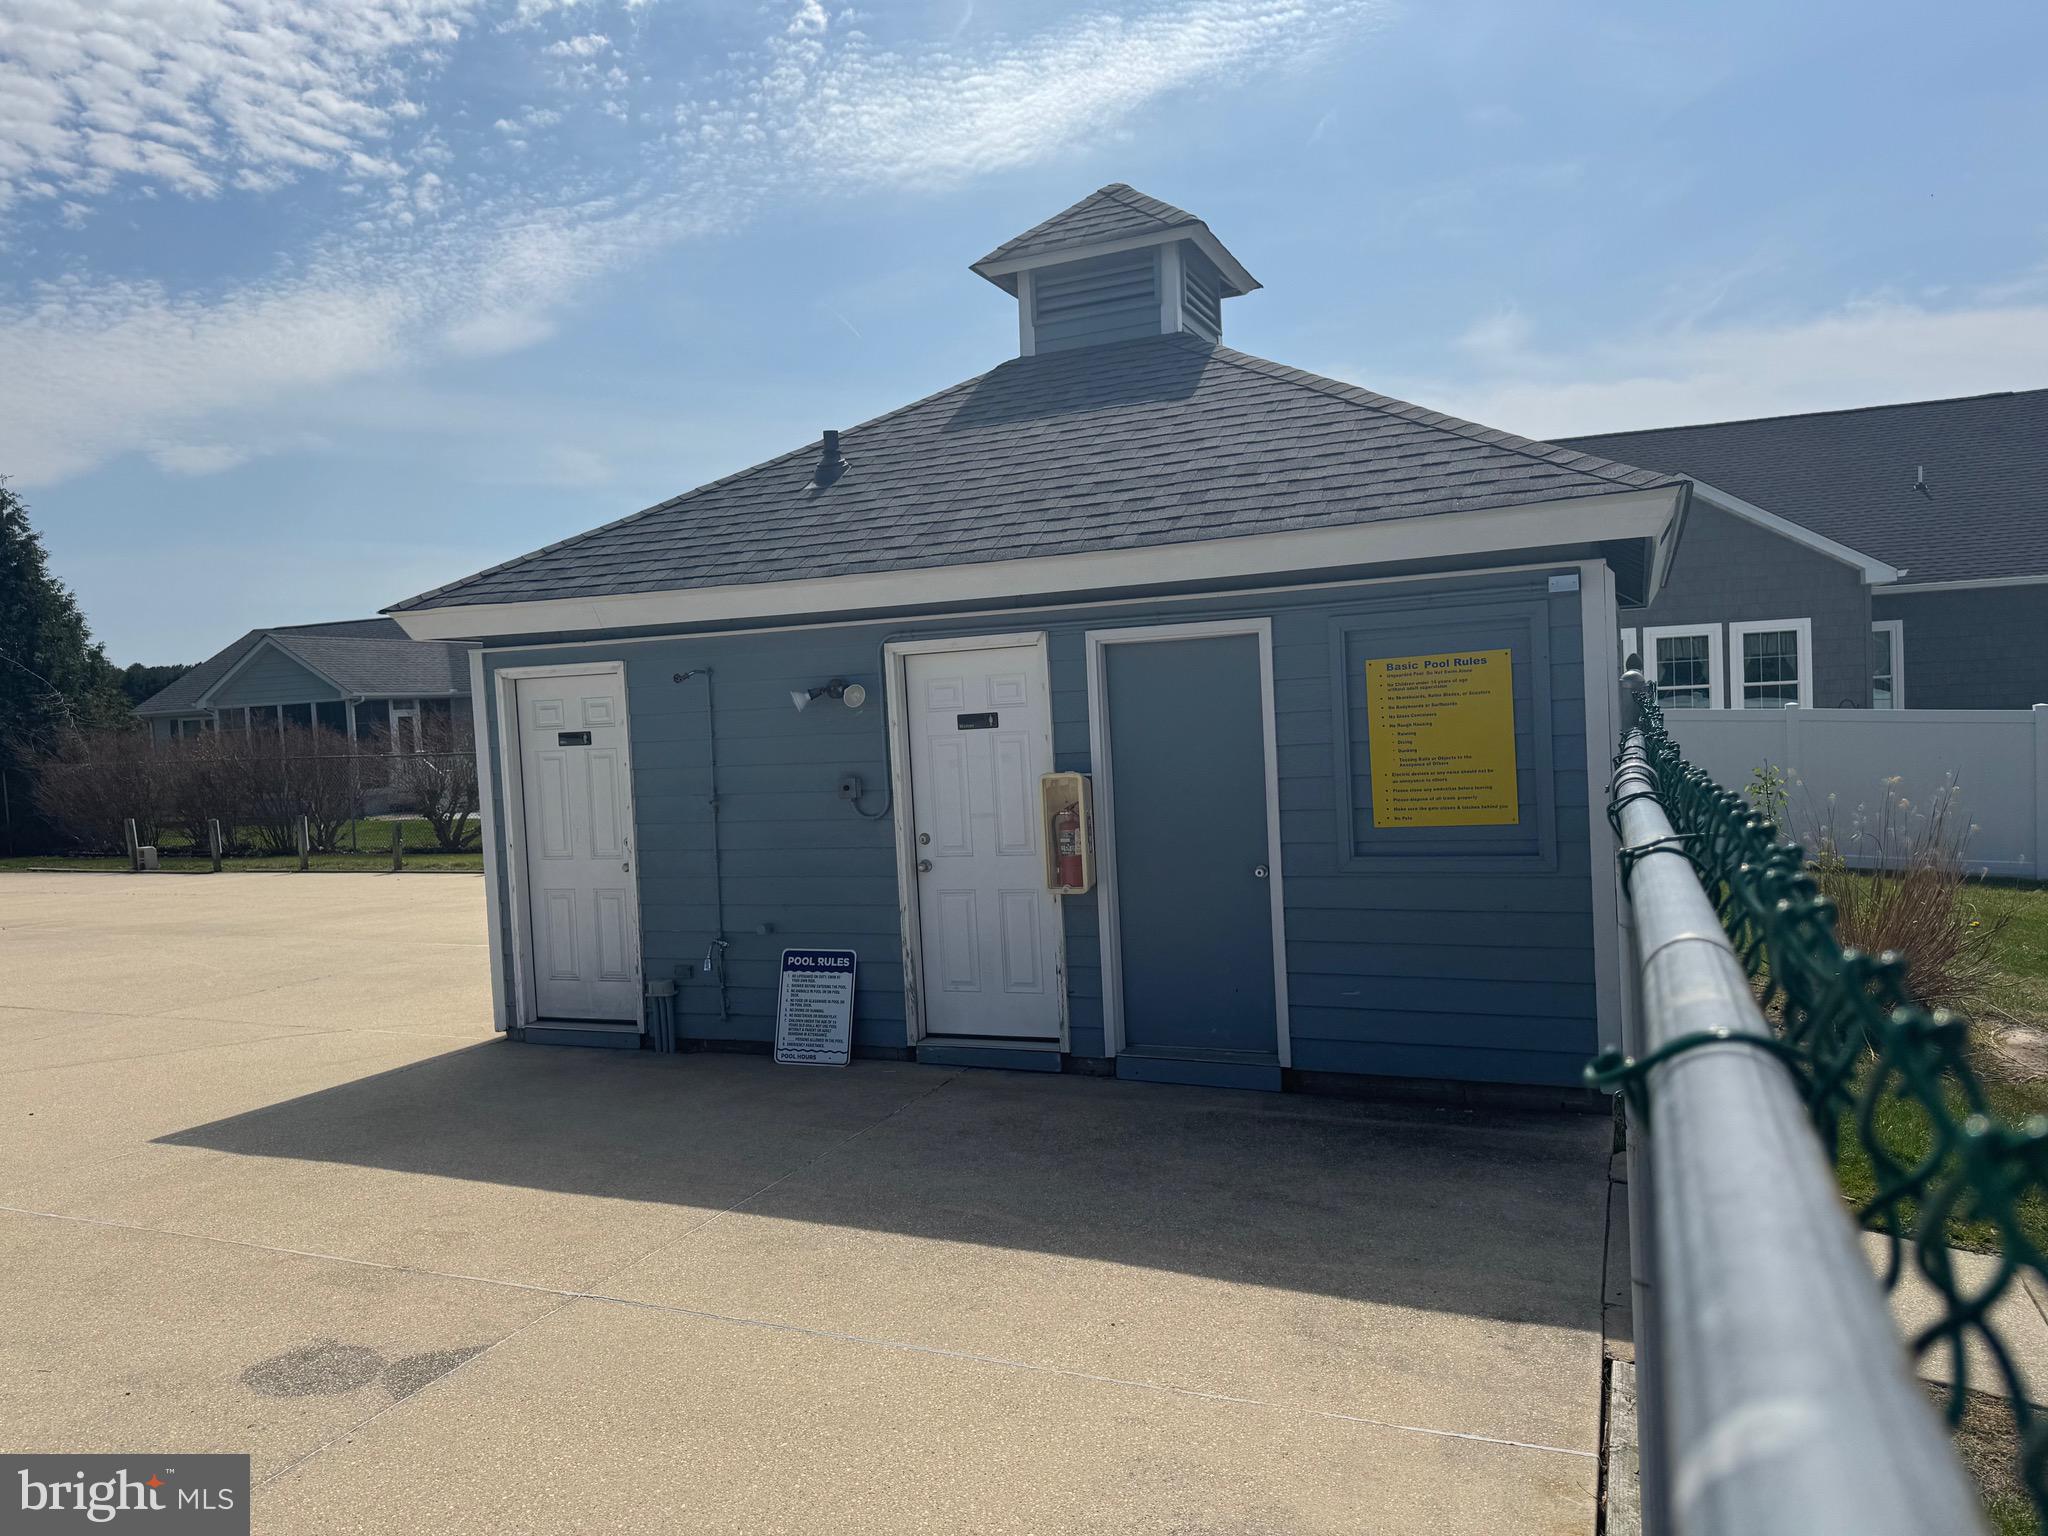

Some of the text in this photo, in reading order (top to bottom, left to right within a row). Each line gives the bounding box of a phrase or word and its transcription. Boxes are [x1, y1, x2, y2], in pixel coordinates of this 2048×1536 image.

[1386, 657, 1488, 671] Basic Pool Rules
[788, 956, 850, 967] POOL RULES
